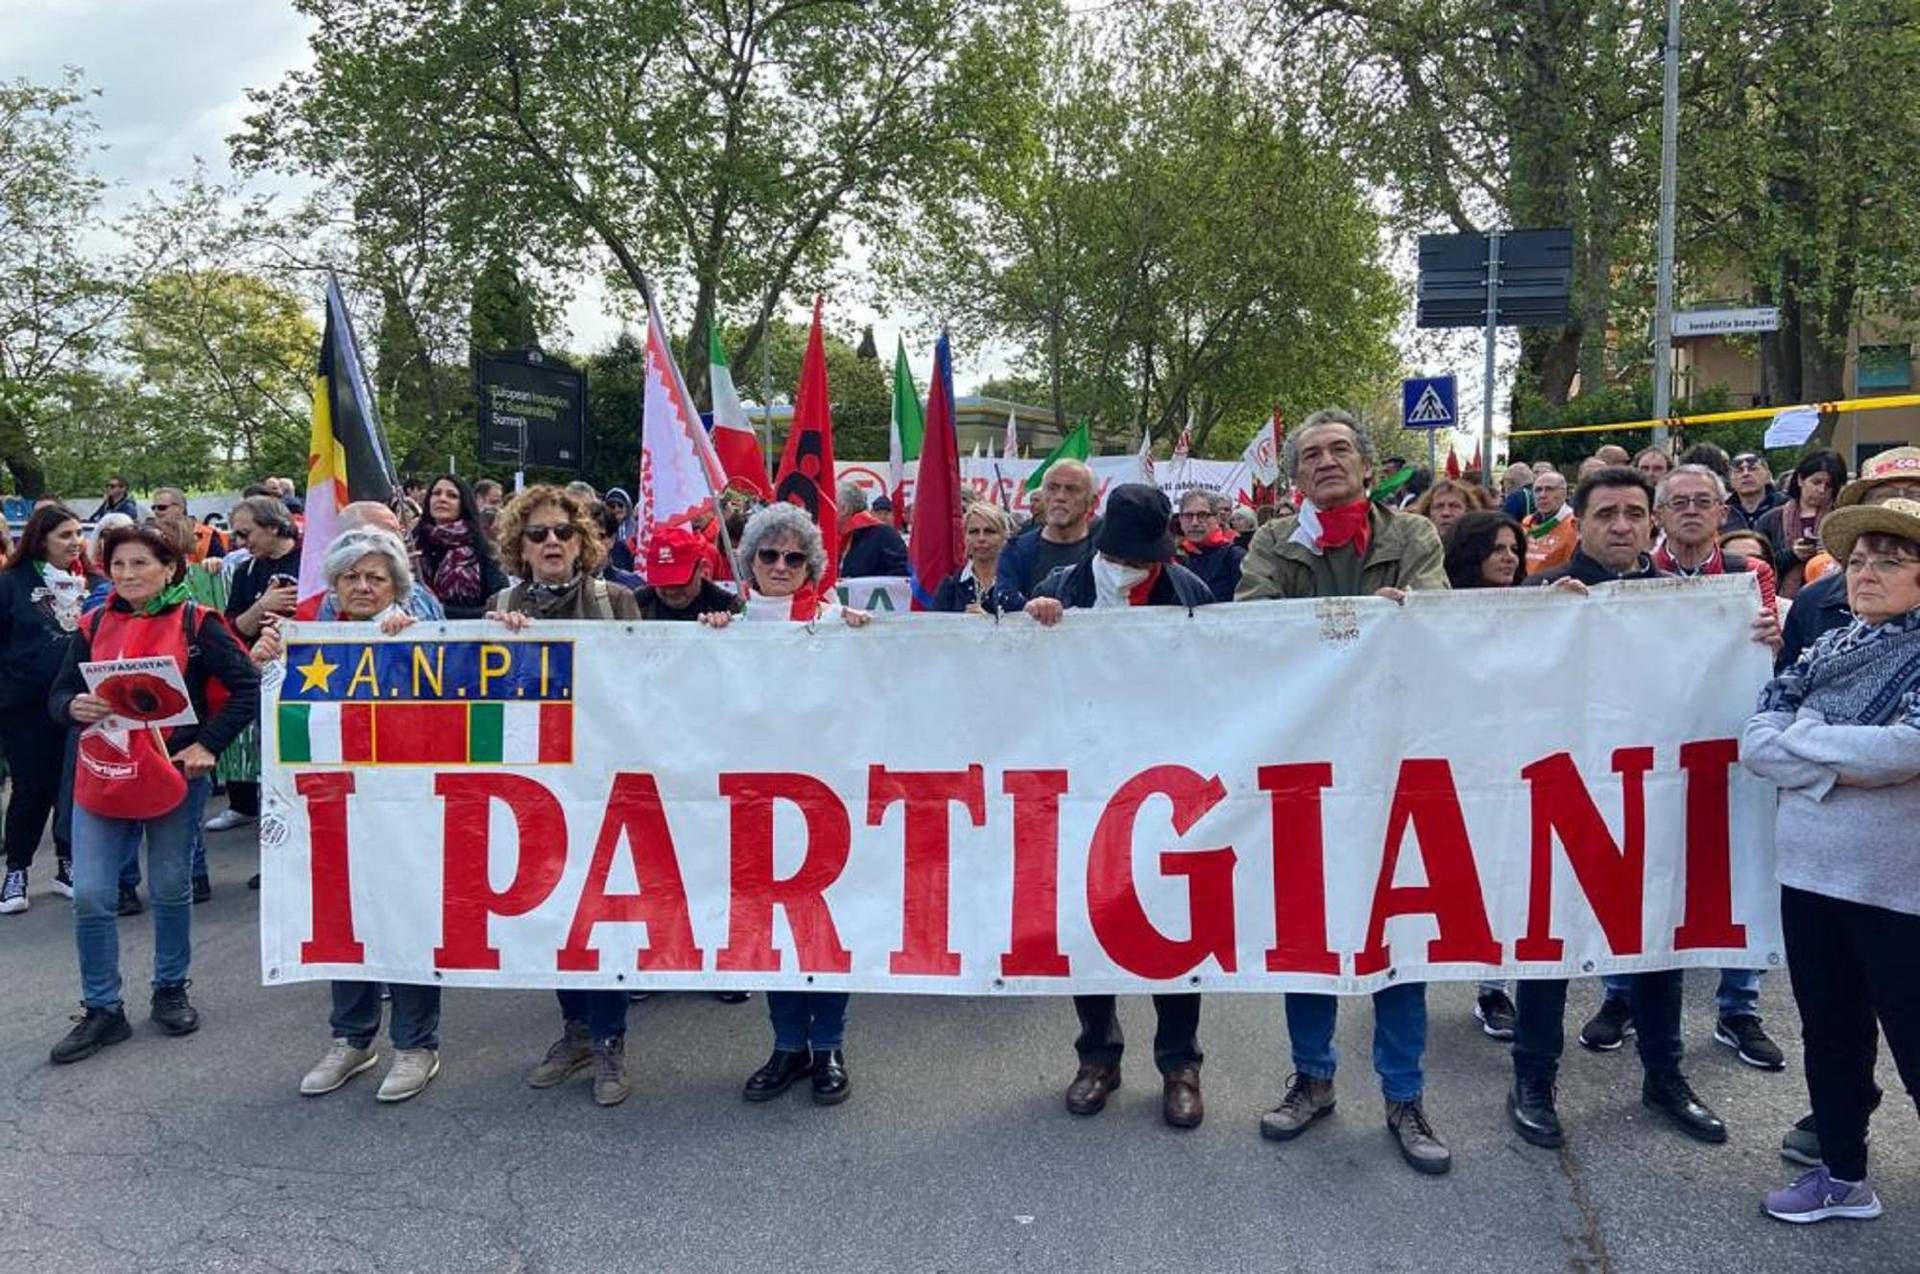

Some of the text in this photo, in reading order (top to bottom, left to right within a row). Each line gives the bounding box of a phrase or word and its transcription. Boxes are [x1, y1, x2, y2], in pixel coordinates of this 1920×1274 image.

[346, 644, 570, 697] A.N.P.I.
[295, 738, 1747, 981] I PARTIGIANI
